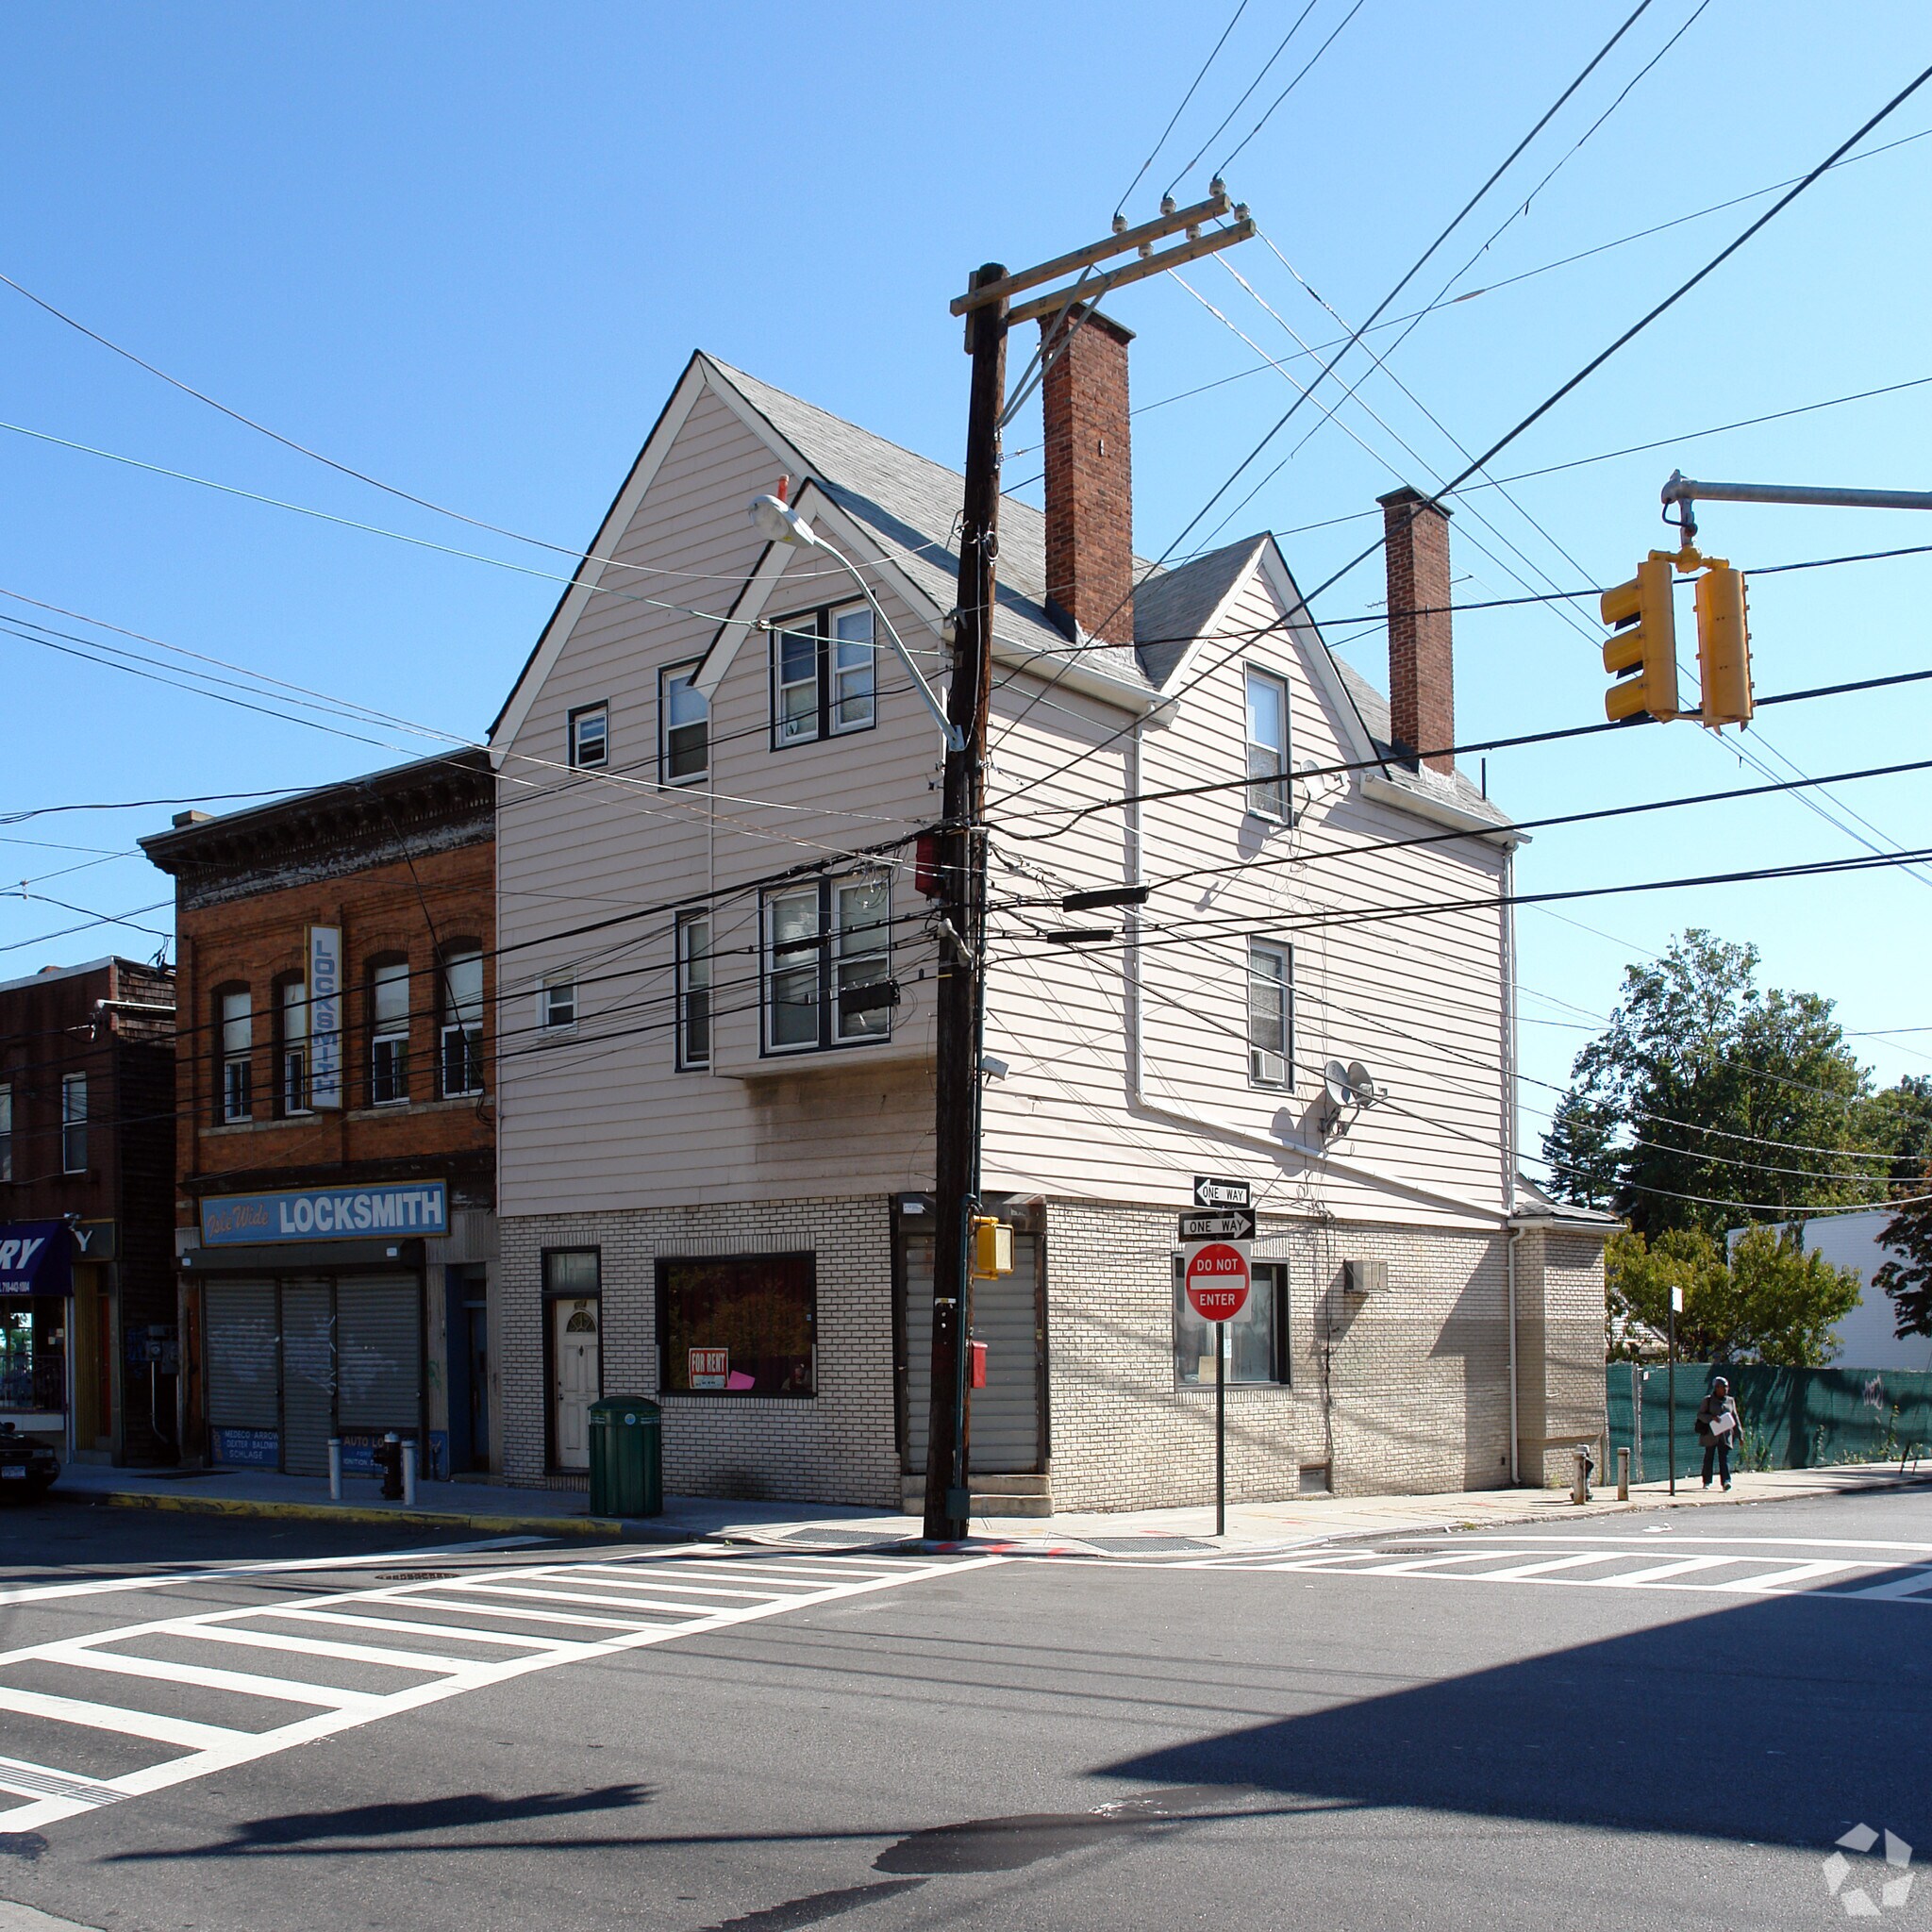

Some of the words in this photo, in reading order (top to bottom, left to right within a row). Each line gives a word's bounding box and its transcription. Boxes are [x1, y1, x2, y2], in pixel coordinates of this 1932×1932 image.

[313, 941, 338, 1094] LOCKSMITH
[1202, 1186, 1219, 1199] ONE
[1226, 1189, 1243, 1201] WAY
[232, 1202, 269, 1229] Wide
[280, 1191, 442, 1233] LOCKSMITH
[1190, 1221, 1212, 1233] ONE
[1221, 1219, 1244, 1231] WAY
[0, 1238, 45, 1271] RY
[1196, 1259, 1212, 1272] DO
[1216, 1258, 1239, 1271] NOT
[1199, 1293, 1236, 1307] ENTER
[691, 1353, 705, 1373] FOR
[707, 1353, 725, 1373] RENT
[225, 1429, 251, 1440] MEDECO
[343, 1436, 369, 1447] AUTO
[226, 1440, 248, 1449] DEXTER
[228, 1449, 263, 1459] SCHLAGE
